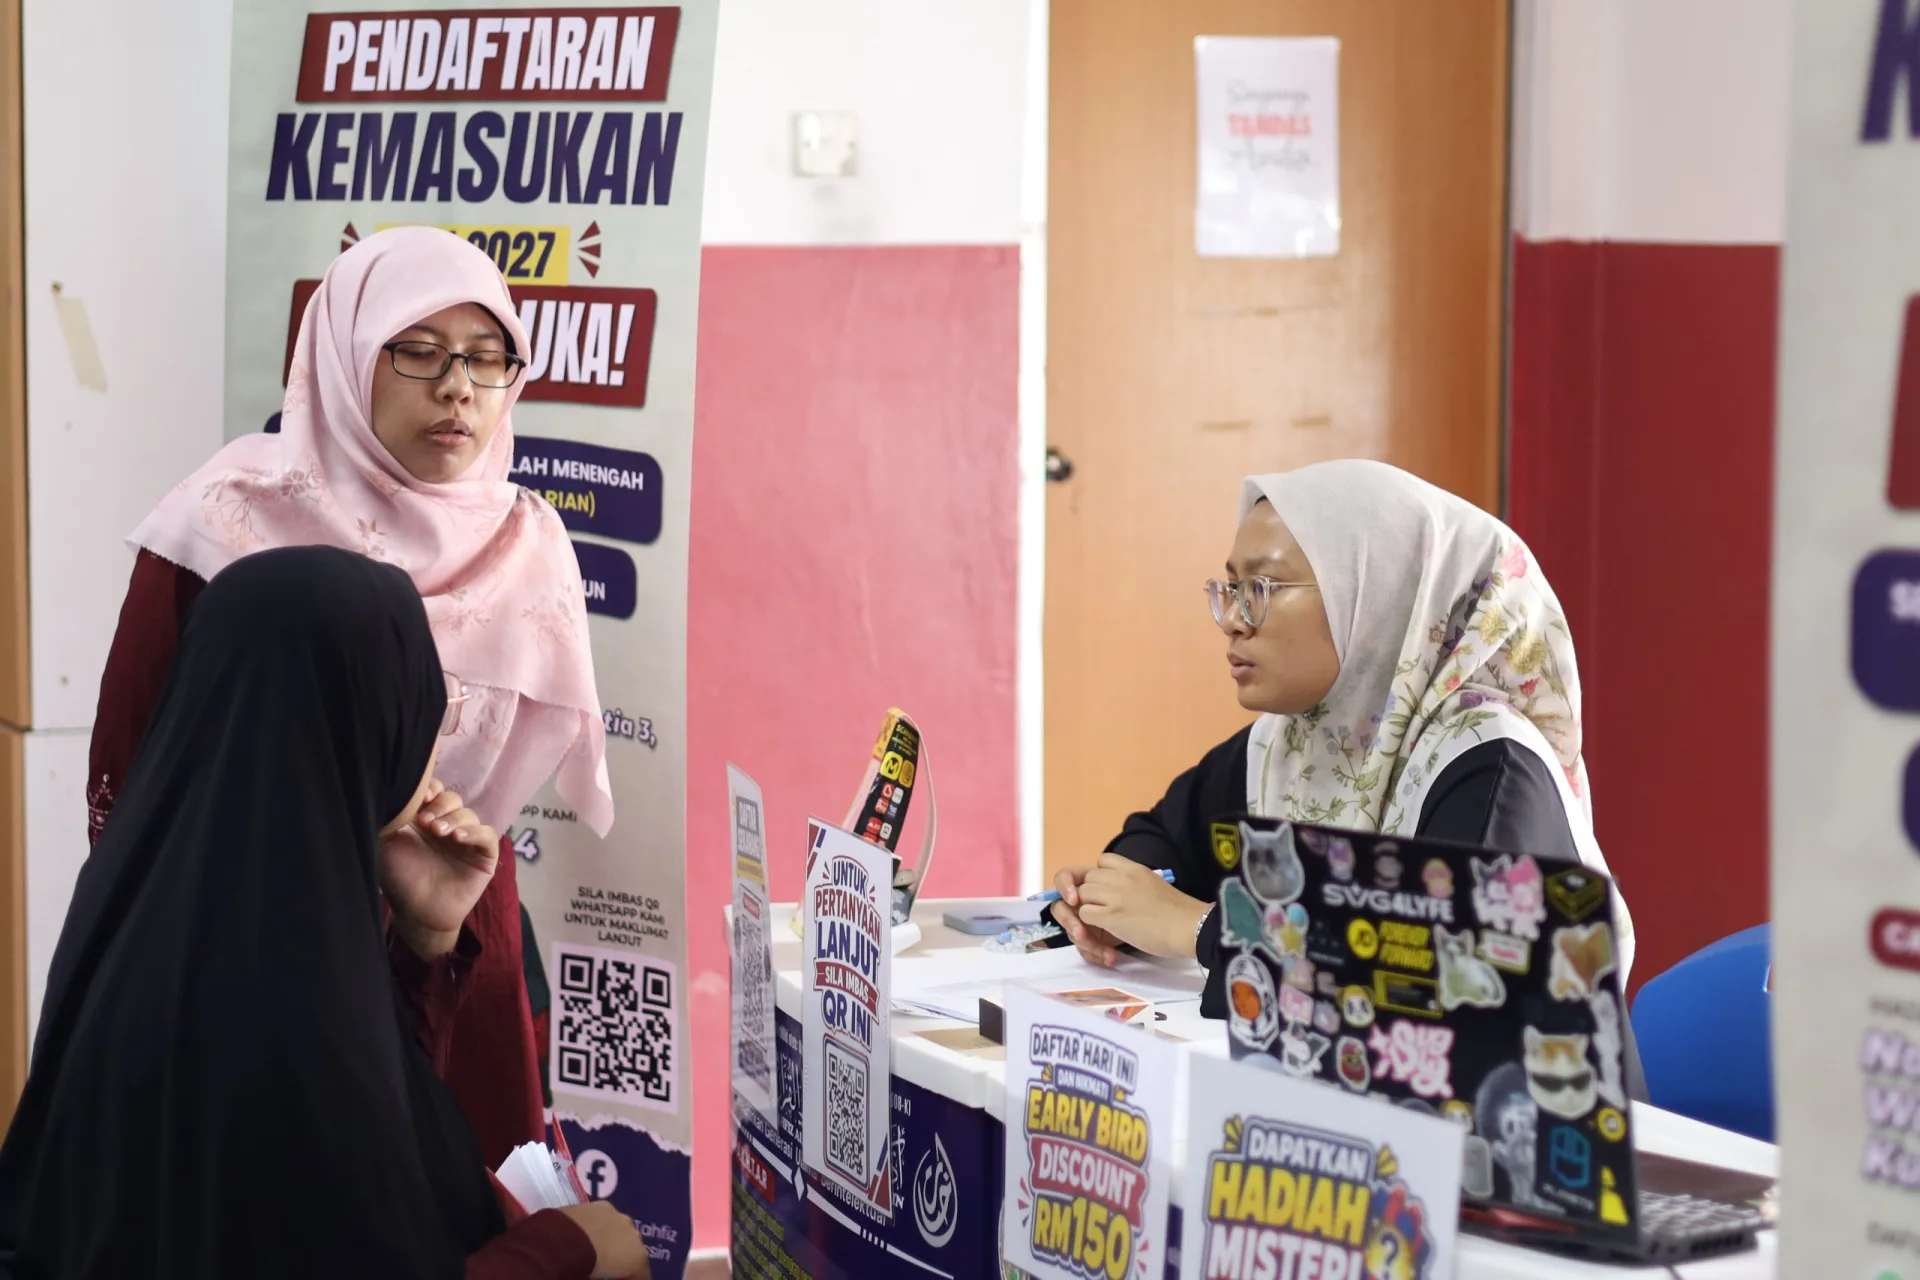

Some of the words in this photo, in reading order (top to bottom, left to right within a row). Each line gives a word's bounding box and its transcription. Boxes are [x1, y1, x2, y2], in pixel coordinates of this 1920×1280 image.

[322, 16, 656, 92] PENDAFTARAN
[265, 110, 683, 206] KEMASUKAN
[516, 299, 635, 387] UKA!
[509, 456, 548, 476] LAH
[553, 458, 644, 491] MENENGAH
[584, 579, 605, 601] UN
[603, 708, 634, 738] tia
[639, 717, 657, 748] 3,
[519, 804, 540, 816] PP
[543, 808, 577, 822] KAMI
[514, 827, 540, 862] 4
[578, 886, 604, 899] SILA
[607, 890, 643, 906] IMBAS
[645, 898, 660, 910] QR
[833, 860, 868, 899] UNTUK
[564, 912, 607, 928] UNTUK
[609, 919, 669, 940] MAKLUMAT
[570, 899, 638, 918] WHATSAPP
[640, 911, 666, 925] KAMI
[815, 887, 881, 945] PERTANYAAN
[597, 931, 642, 947] LANJUT
[817, 920, 879, 985] LANJUT
[825, 966, 844, 988] SILA
[845, 970, 869, 1004] IMBAS
[823, 989, 847, 1030] QR
[851, 1001, 871, 1047] INI
[1033, 1032, 1080, 1062] DAFTAR
[1083, 1041, 1113, 1074] HARI
[1116, 1053, 1136, 1086] INI
[1057, 1068, 1075, 1089] DAN
[1028, 1088, 1095, 1140] EARLY
[1096, 1105, 1147, 1161] BIRD
[1038, 1142, 1136, 1209] DISCOUNT
[1248, 1127, 1370, 1182] DAPATKAN
[1208, 1160, 1370, 1246] HADIAH
[1034, 1196, 1131, 1280] RM150
